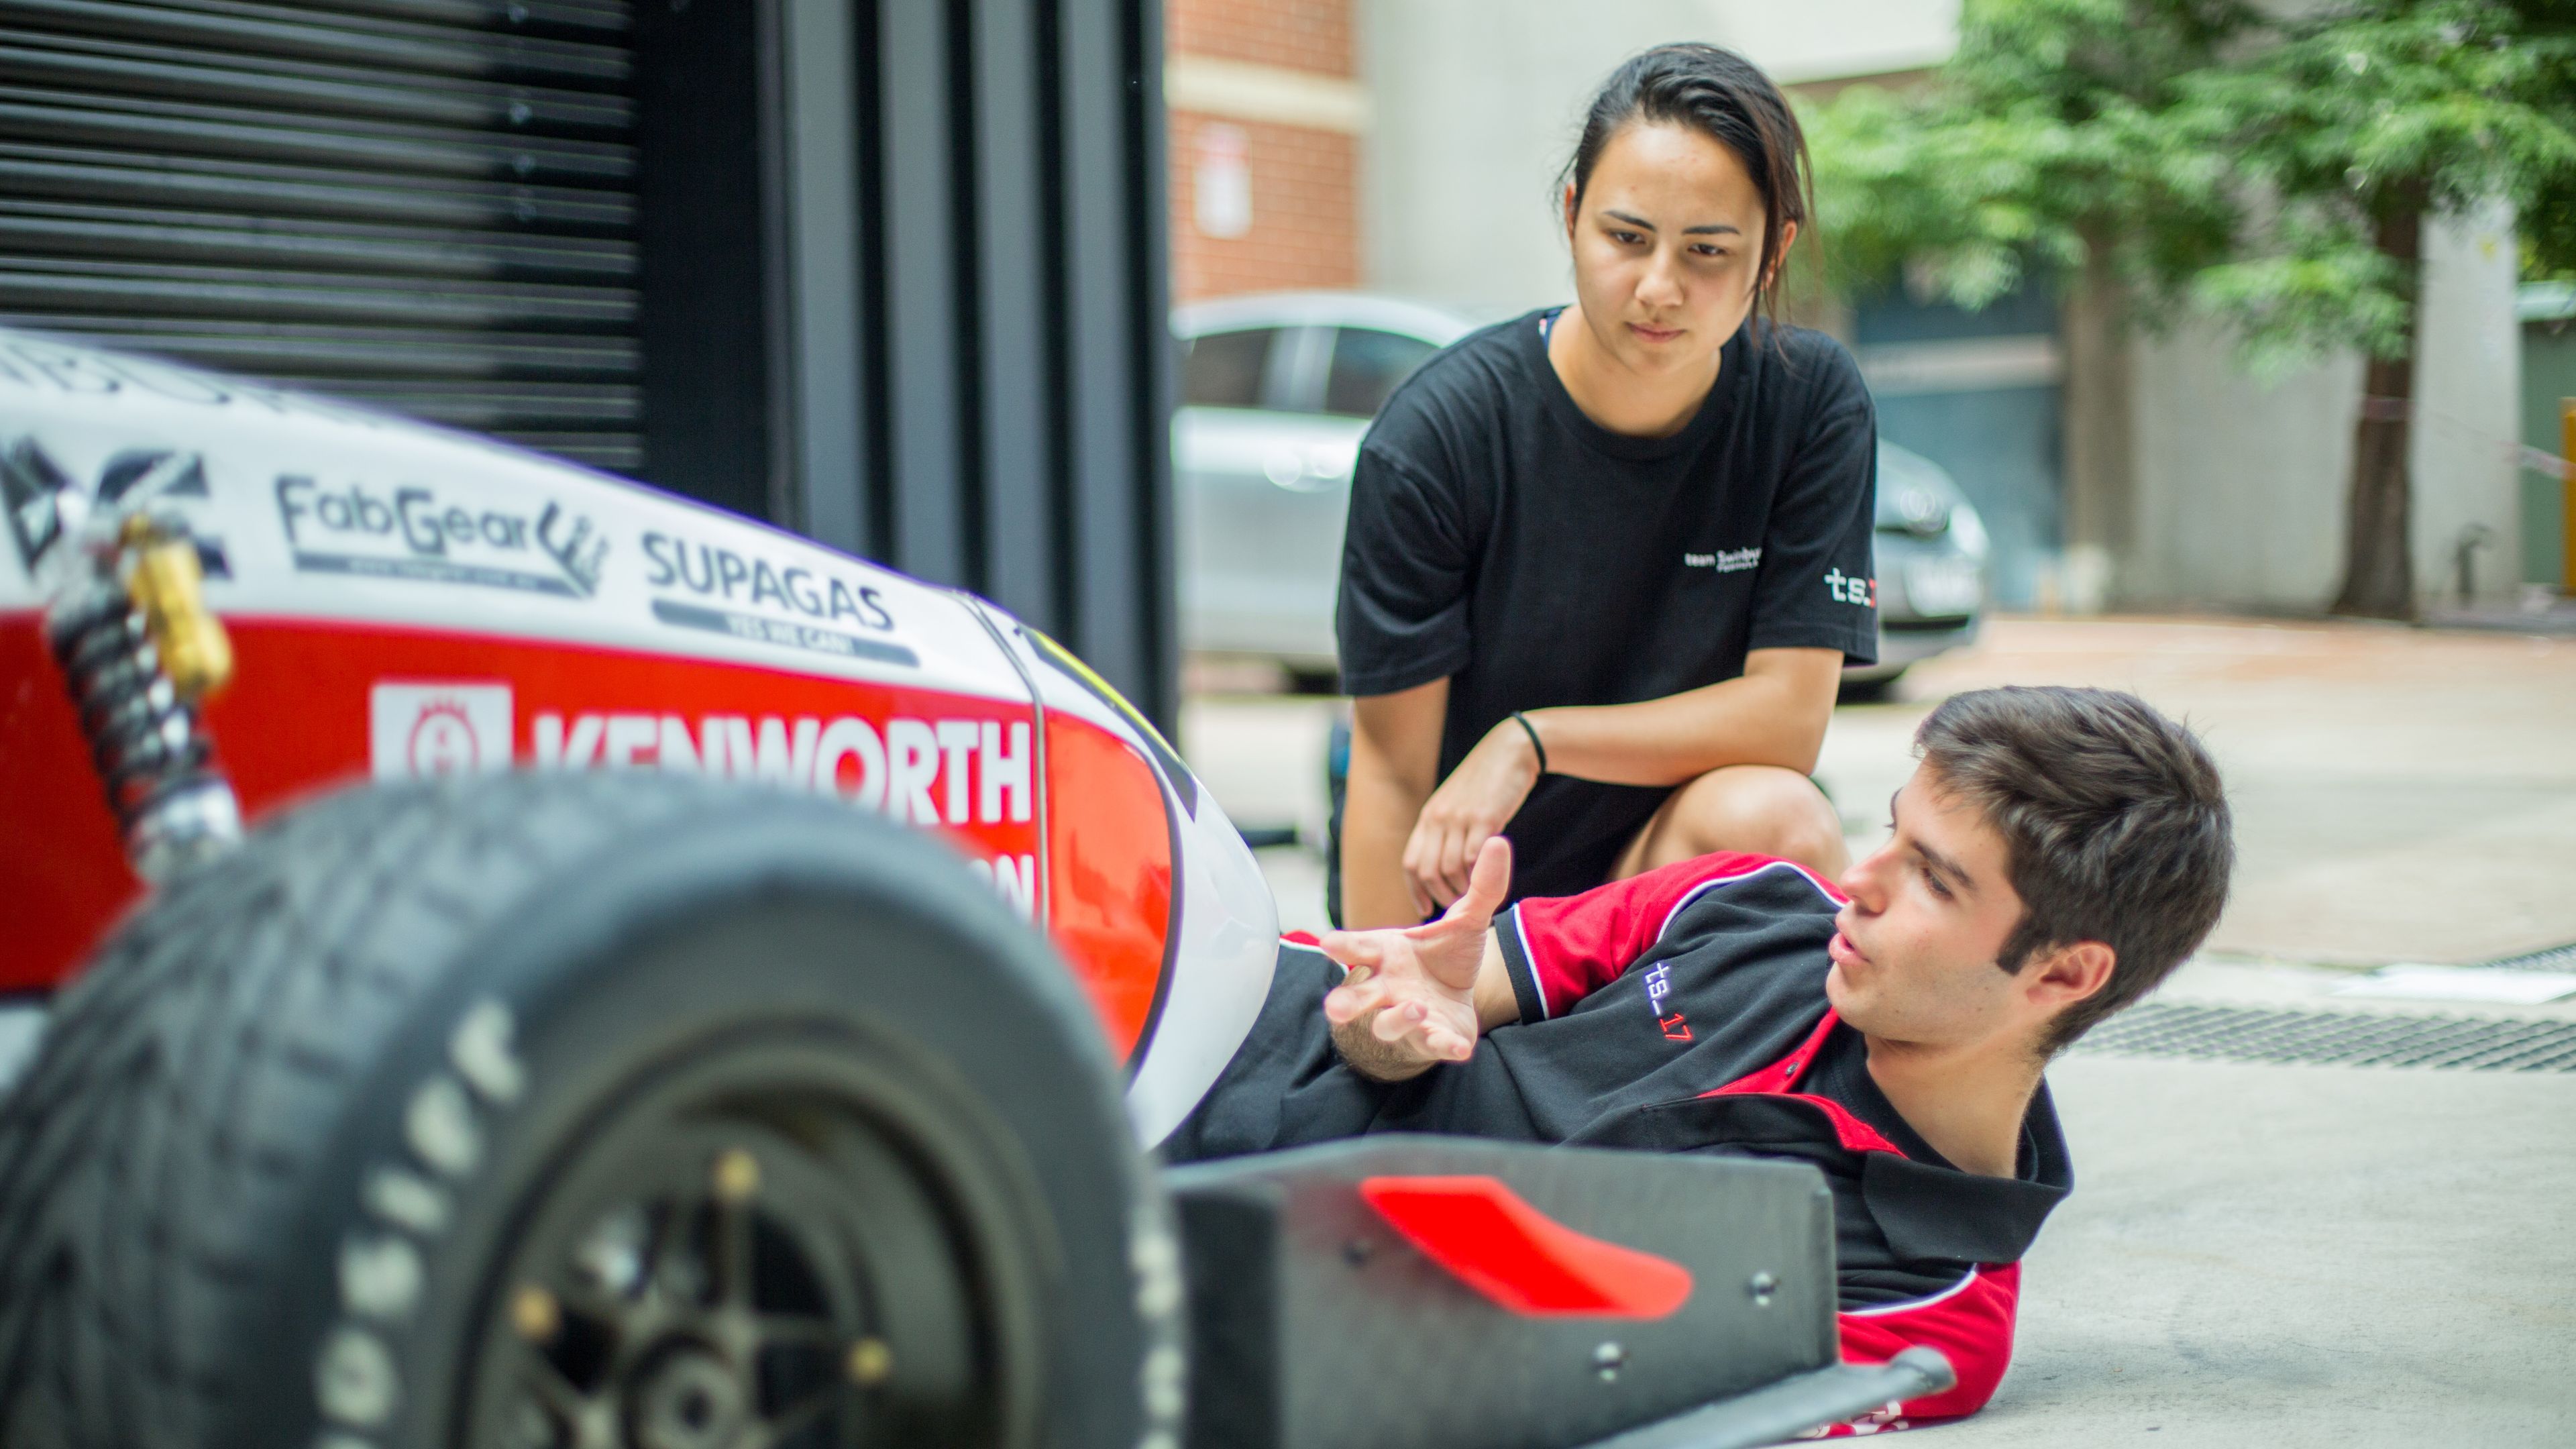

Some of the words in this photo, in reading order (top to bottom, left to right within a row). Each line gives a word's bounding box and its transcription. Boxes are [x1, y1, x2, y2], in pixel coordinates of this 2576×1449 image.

[276, 474, 529, 556] FabGear
[1684, 553, 1716, 568] team
[642, 532, 894, 632] SUPAGAS
[537, 716, 1031, 823] KENWORTH
